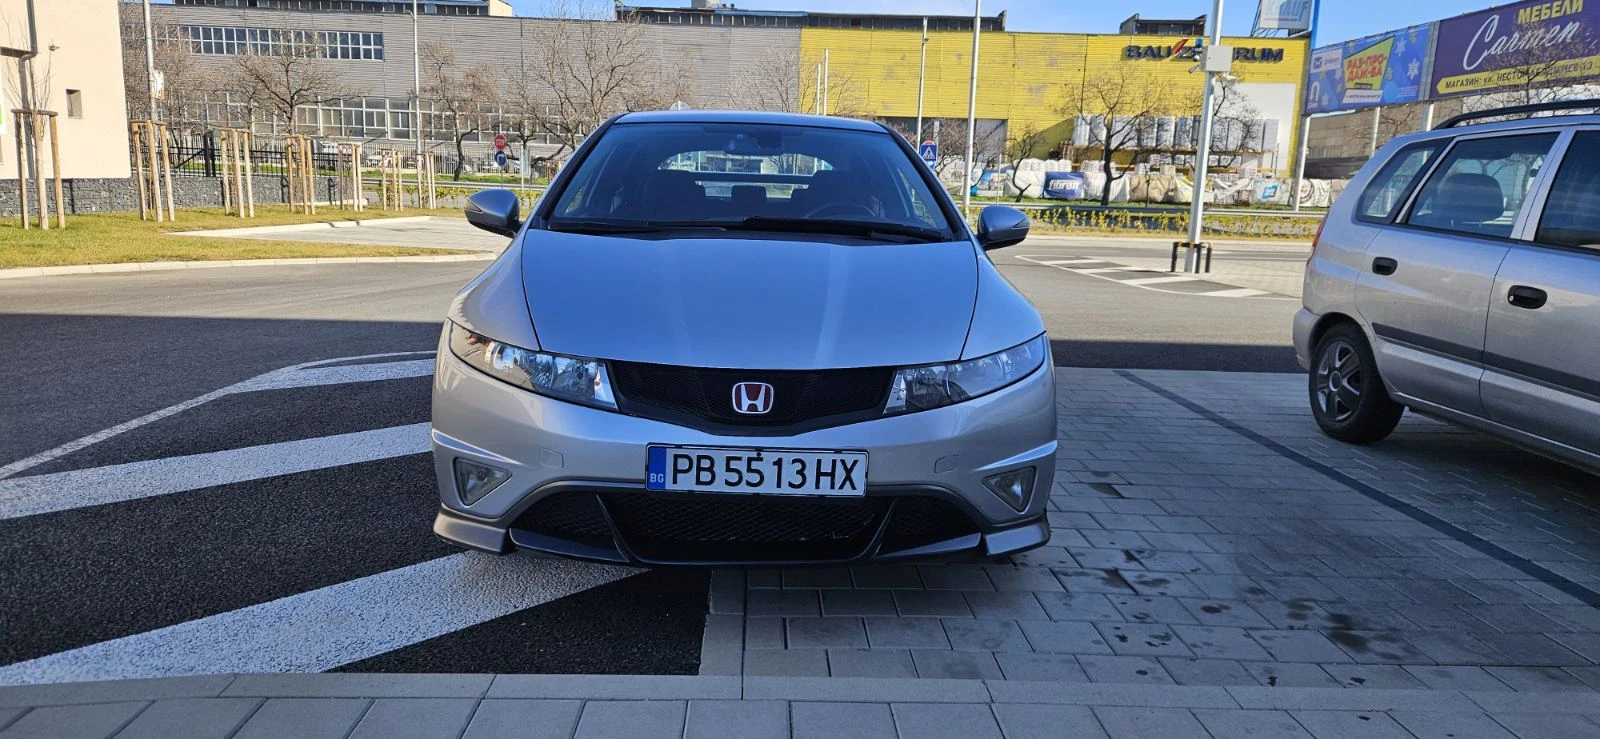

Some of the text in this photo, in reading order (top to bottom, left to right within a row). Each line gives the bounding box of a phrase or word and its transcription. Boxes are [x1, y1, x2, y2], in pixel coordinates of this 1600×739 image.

[1517, 0, 1584, 24] МЕБЕЛИ
[1463, 14, 1581, 70] Carmen
[1445, 77, 1482, 89] МАГАЗИН:
[650, 473, 664, 483] BG
[672, 453, 859, 491] PB 5513 HX
